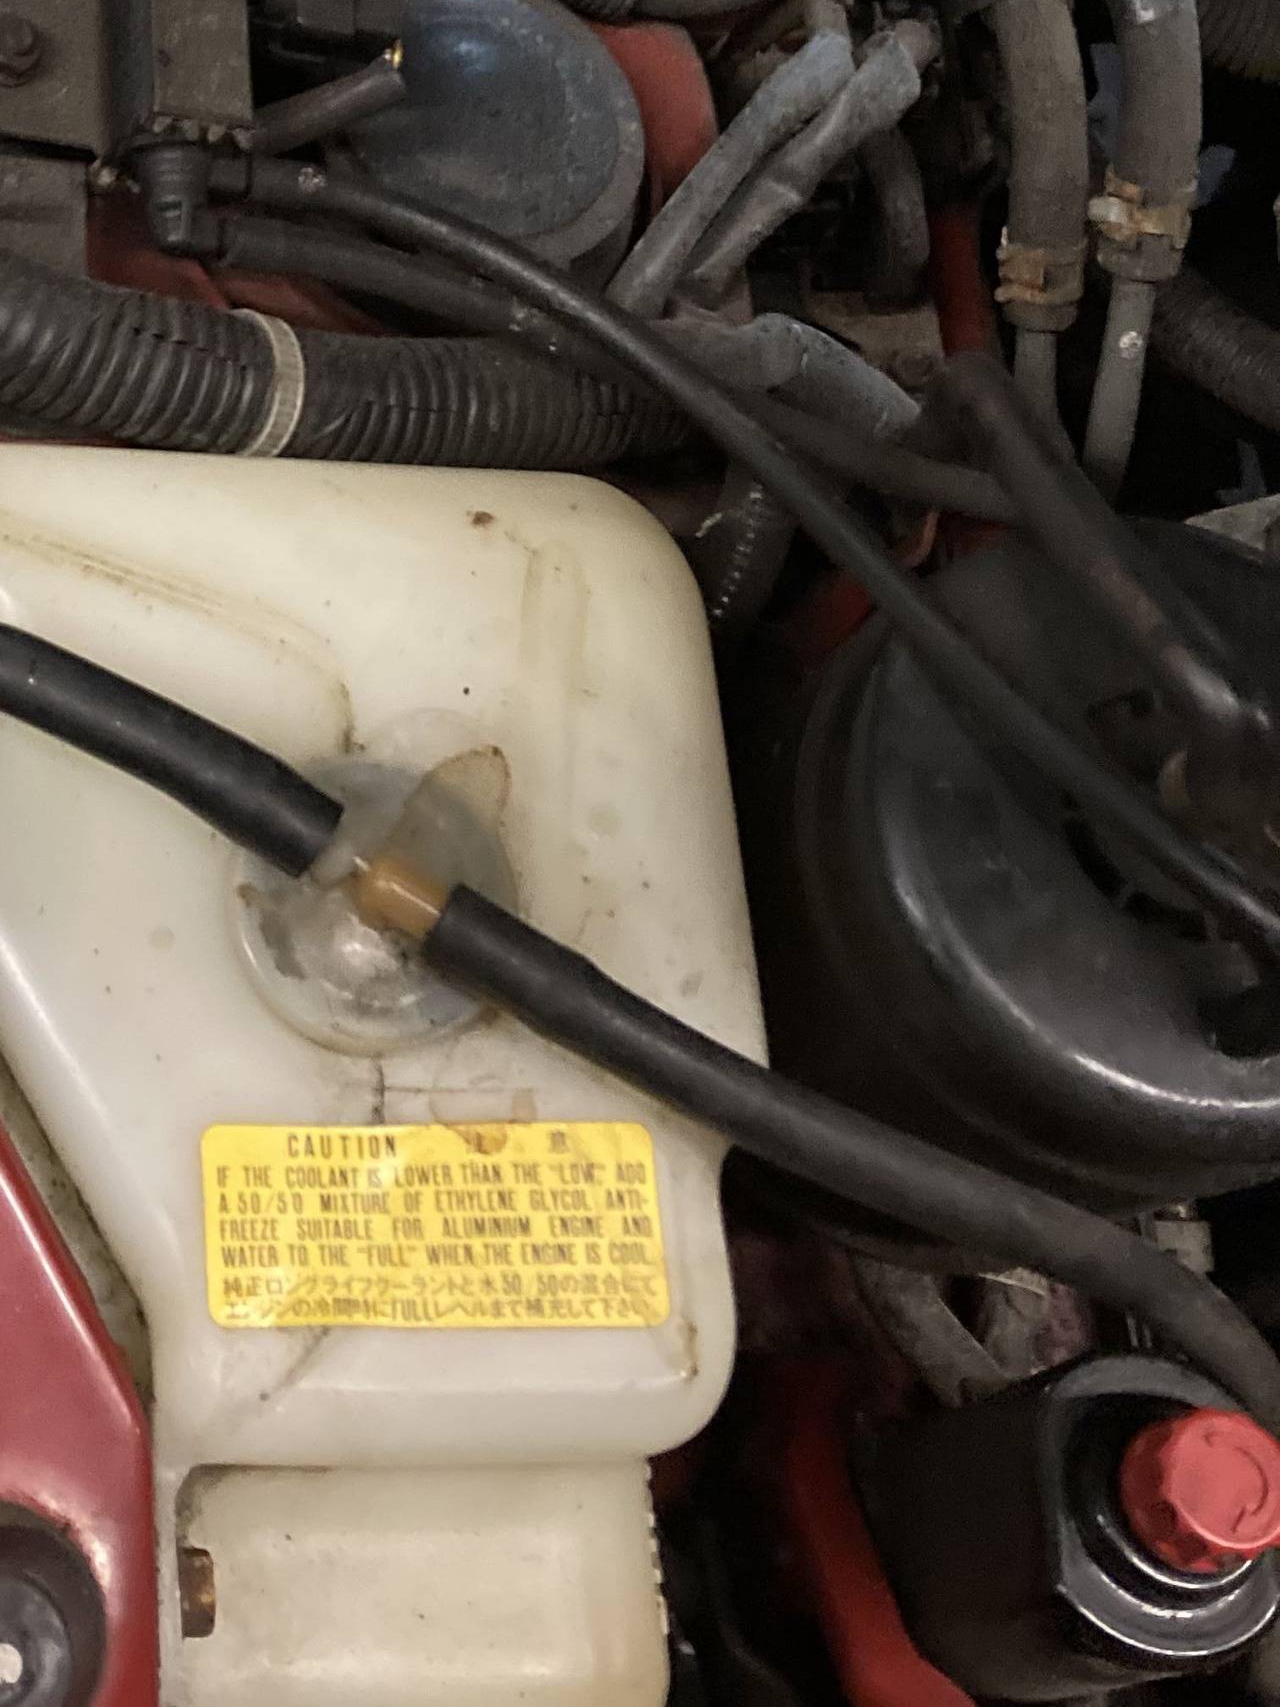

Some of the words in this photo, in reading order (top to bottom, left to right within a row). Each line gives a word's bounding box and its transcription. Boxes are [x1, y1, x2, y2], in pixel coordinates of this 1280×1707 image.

[287, 1133, 397, 1160] CAUTION
[216, 1165, 230, 1189] IF
[242, 1165, 272, 1189] THE
[285, 1165, 359, 1189] COOLANT
[394, 1163, 452, 1188] LOWER
[460, 1162, 502, 1186] THAN
[512, 1162, 541, 1185] THE
[219, 1192, 230, 1215] A
[237, 1191, 304, 1215] 50/50
[320, 1191, 391, 1215] MIXTURE
[403, 1191, 423, 1213] OF
[434, 1189, 518, 1212] ETHYLENE
[529, 1189, 592, 1212] GLYCOL
[220, 1218, 280, 1242] FREEZE
[296, 1218, 374, 1242] SUITABLE
[392, 1217, 424, 1240] FOR
[549, 1215, 604, 1238] ENGINE
[622, 1215, 654, 1238] AND
[221, 1244, 280, 1268] WATER
[287, 1244, 309, 1268] TO
[318, 1244, 351, 1267] THE
[357, 1243, 418, 1267] "FULL"
[425, 1242, 475, 1266] WHEN
[483, 1242, 513, 1266] THE
[521, 1241, 578, 1266] ENGINE
[585, 1241, 602, 1265] IS
